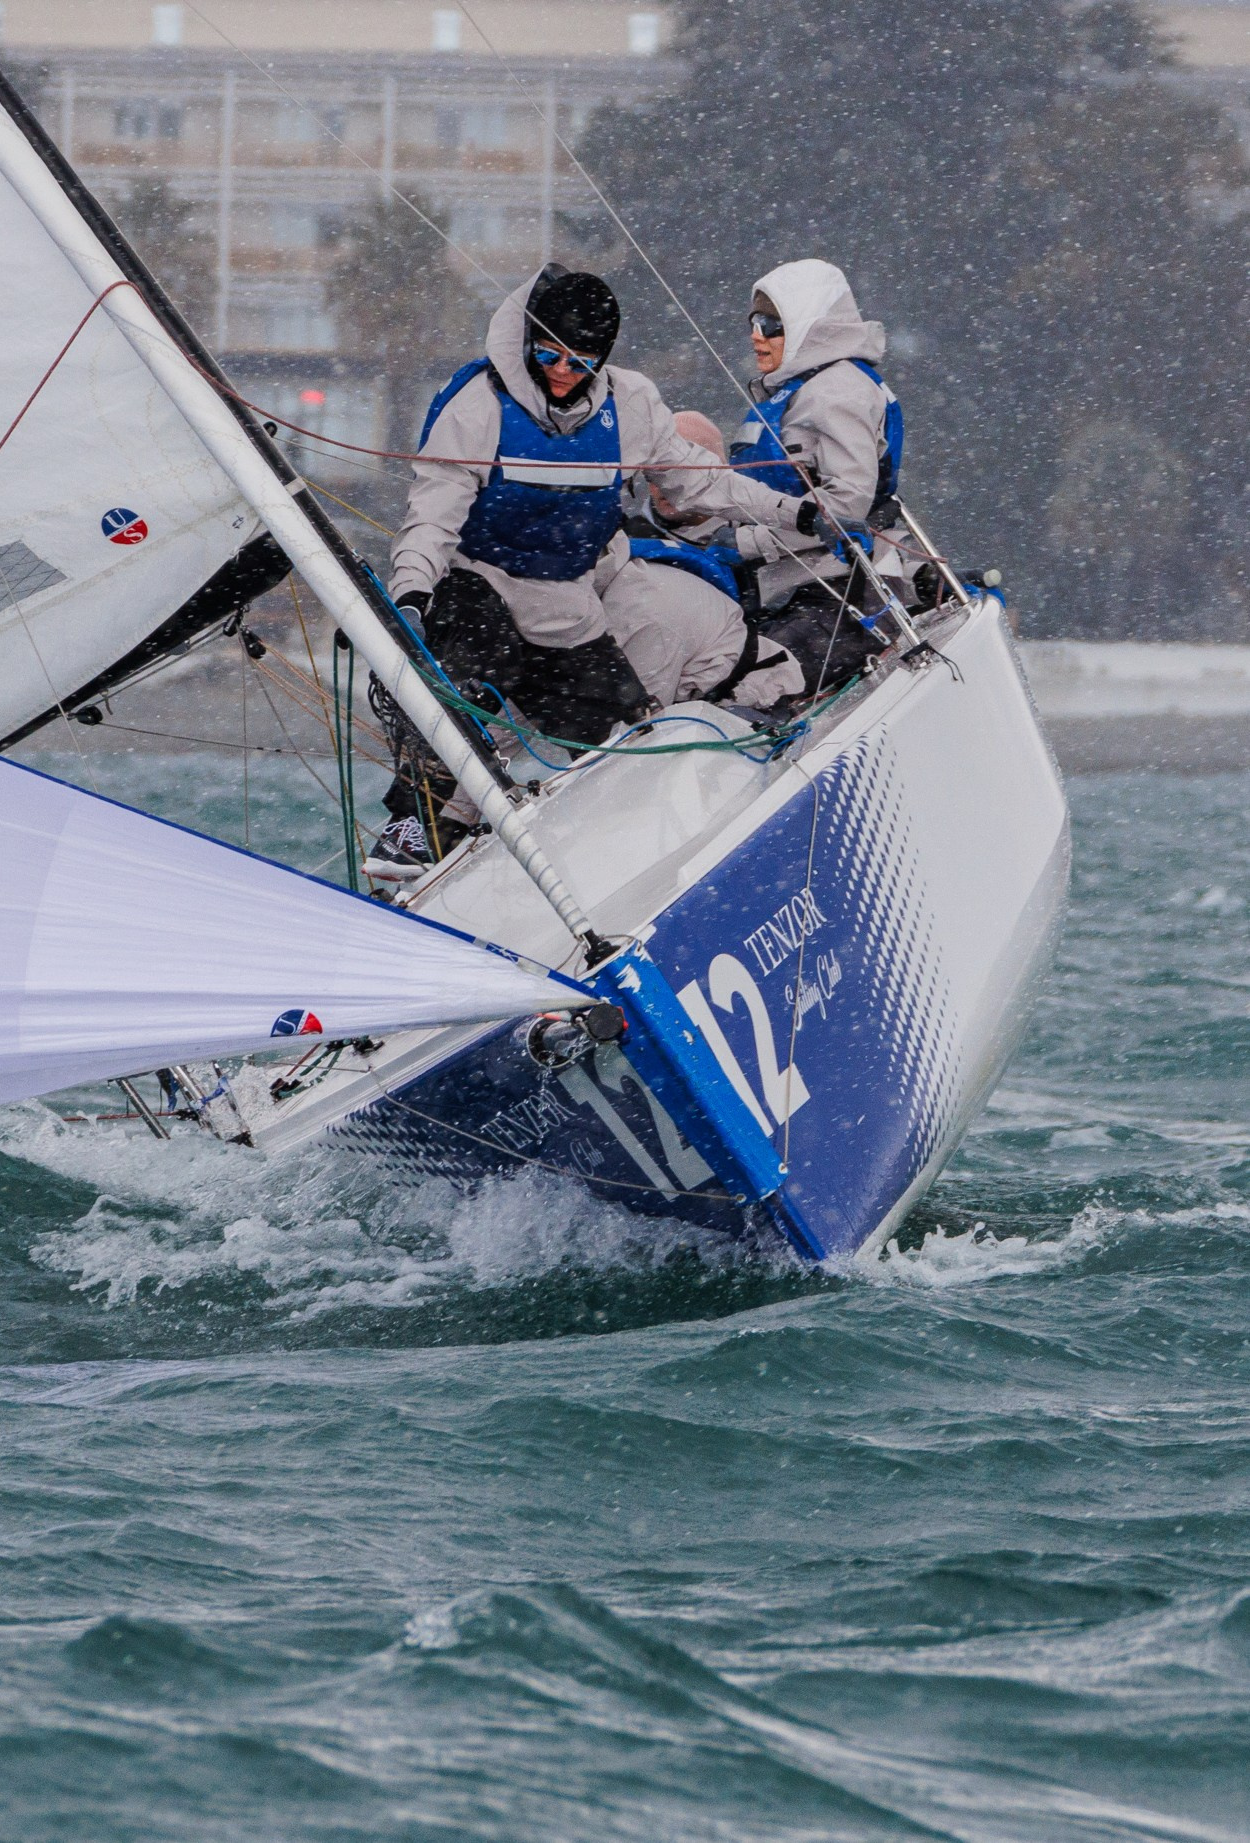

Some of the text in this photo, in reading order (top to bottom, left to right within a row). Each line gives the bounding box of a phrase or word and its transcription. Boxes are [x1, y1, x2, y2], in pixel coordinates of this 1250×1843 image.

[742, 887, 828, 977] TENZOR
[816, 948, 842, 1000] Club
[676, 953, 811, 1138] 12
[479, 1088, 578, 1151] TENZOR
[556, 1042, 715, 1203] 12
